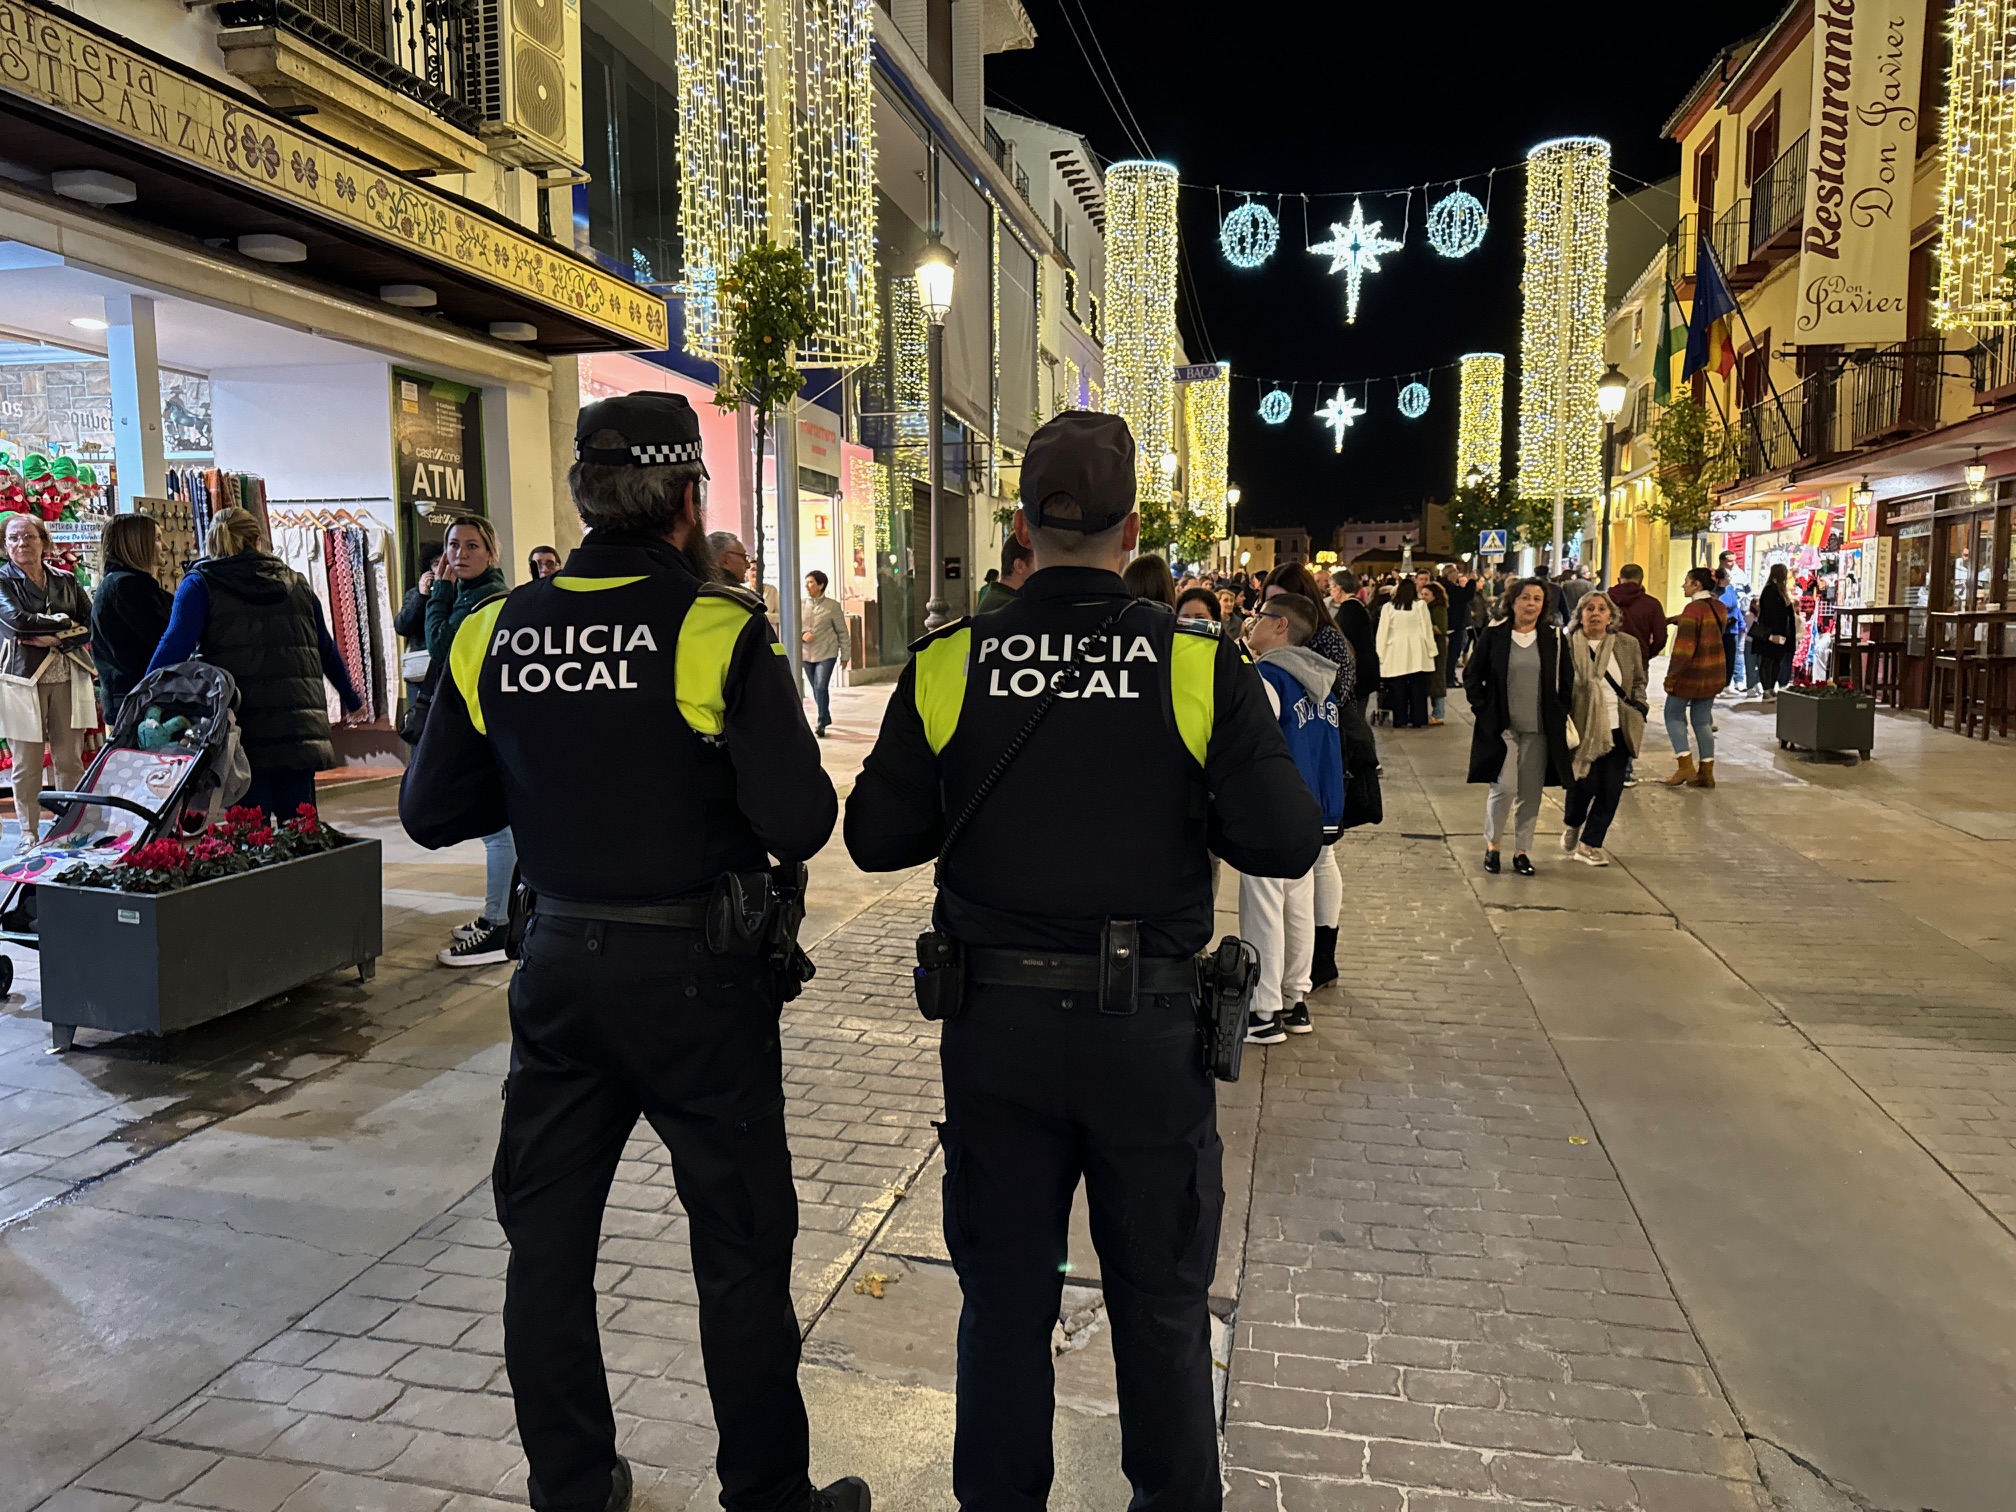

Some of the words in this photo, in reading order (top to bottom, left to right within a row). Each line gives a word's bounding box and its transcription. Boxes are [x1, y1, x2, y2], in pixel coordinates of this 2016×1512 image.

[1856, 16, 1917, 132] Javier
[1804, 0, 1856, 260] Restaurante
[1850, 142, 1897, 228] Don
[1827, 274, 1863, 294] Don
[1797, 275, 1906, 332] Javier
[1186, 366, 1216, 379] BACA
[411, 462, 466, 502] ATM
[490, 624, 658, 656] POLICIA
[978, 633, 1158, 664] POLICIA
[501, 660, 638, 693] LOCAL
[989, 668, 1140, 699] LOCAL
